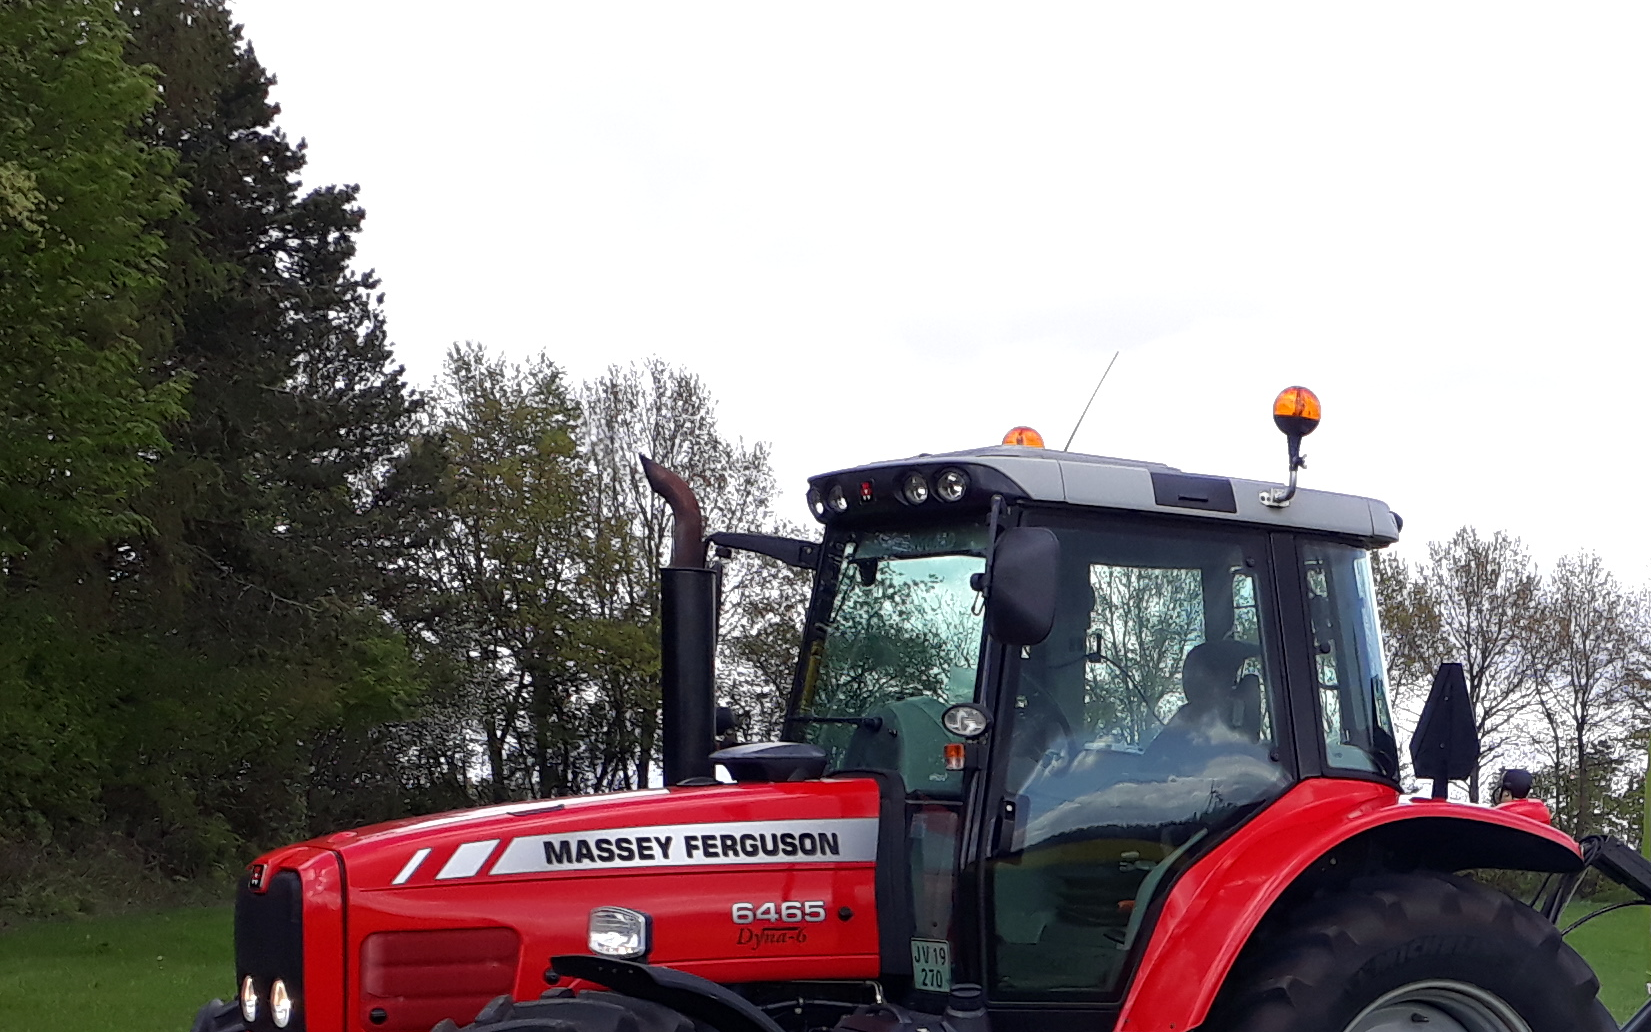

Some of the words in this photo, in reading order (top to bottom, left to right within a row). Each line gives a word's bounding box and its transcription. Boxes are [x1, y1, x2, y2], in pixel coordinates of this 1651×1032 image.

[543, 836, 673, 864] MASSEY
[684, 832, 841, 859] FERGUSON
[732, 901, 826, 924] 6465
[736, 926, 807, 951] Dyna-6
[914, 945, 930, 963] JV
[933, 947, 946, 965] 19
[921, 968, 943, 987] 270
